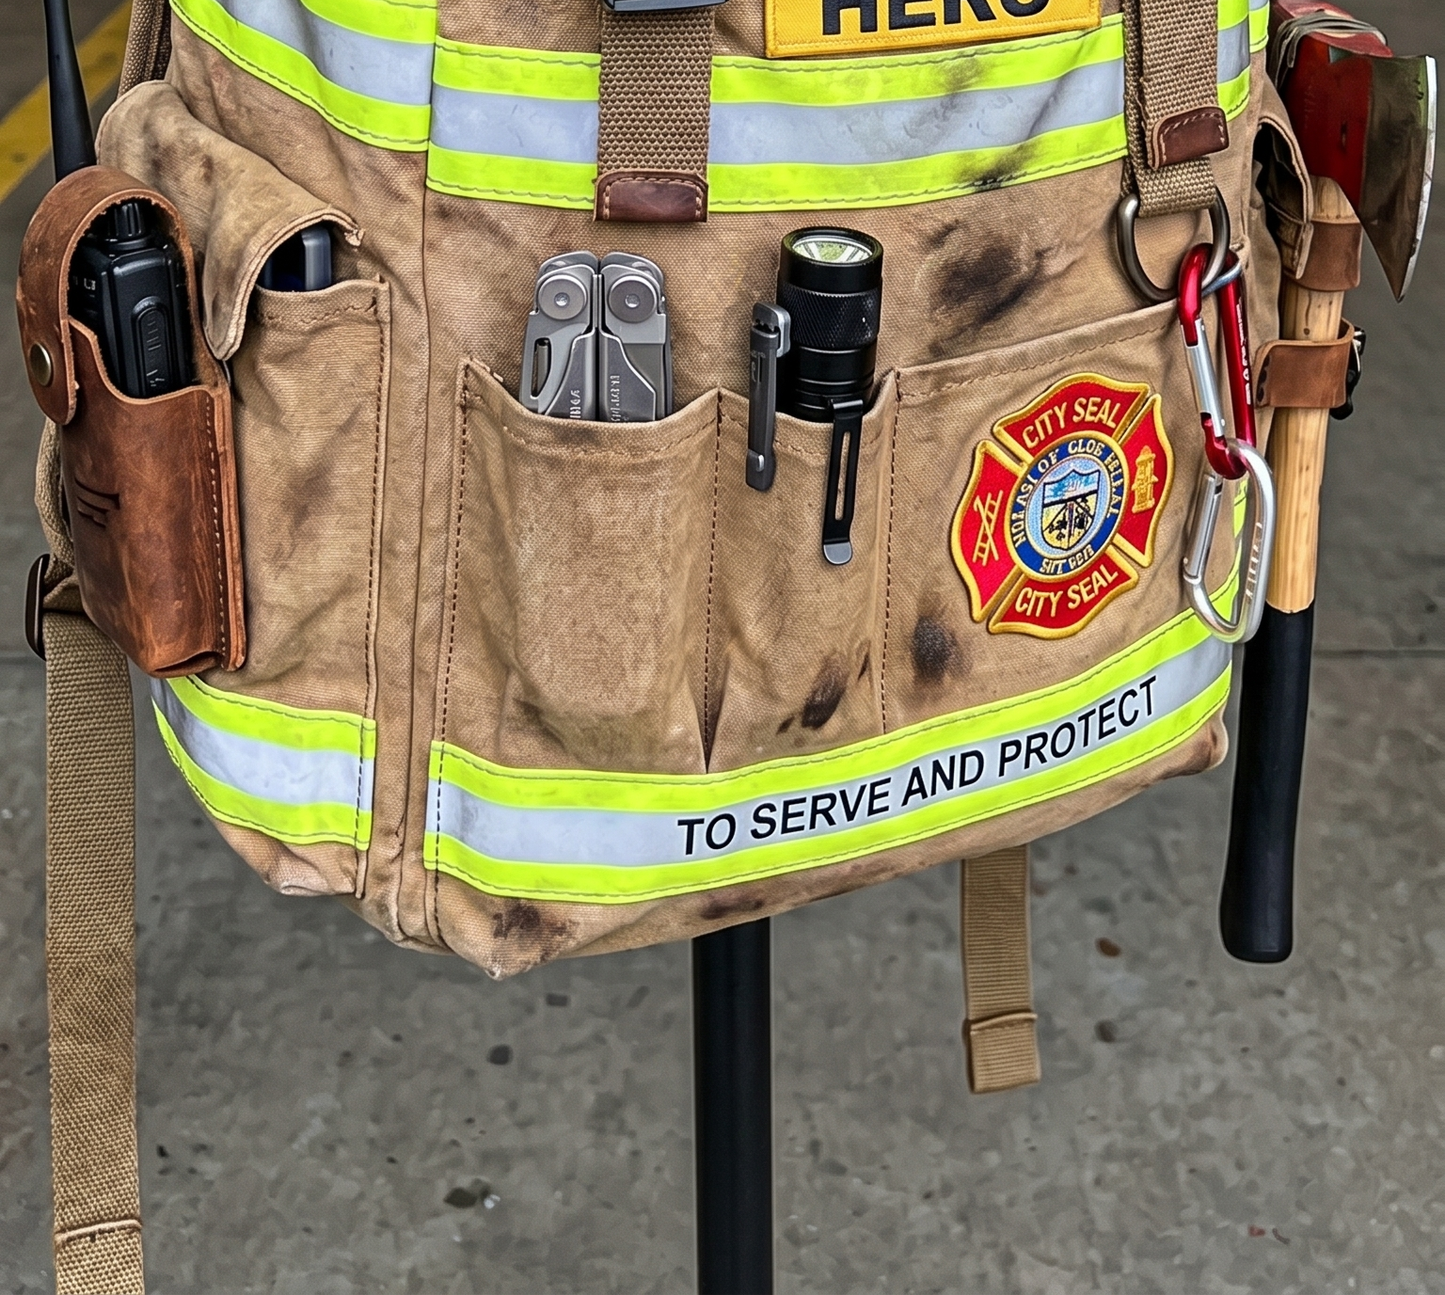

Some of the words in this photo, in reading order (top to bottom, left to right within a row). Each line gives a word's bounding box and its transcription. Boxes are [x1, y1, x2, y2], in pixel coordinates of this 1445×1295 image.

[1022, 401, 1068, 449] CITY
[1072, 396, 1121, 429] SEAL
[1015, 587, 1064, 618] CITY
[1067, 564, 1119, 610] SEAL
[677, 813, 737, 855] TO
[750, 777, 892, 840] SERVE
[901, 749, 985, 807] AND
[998, 675, 1157, 778] PROTECT
